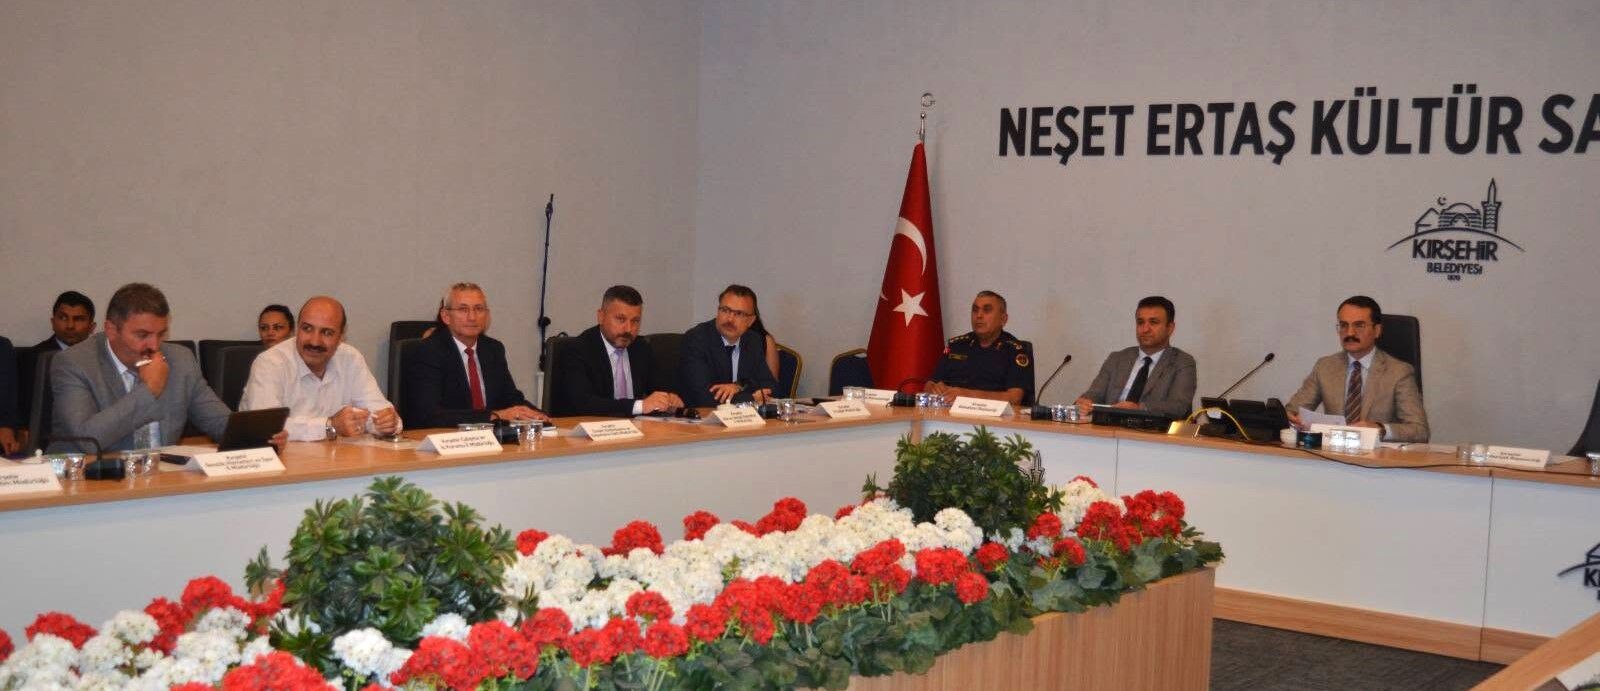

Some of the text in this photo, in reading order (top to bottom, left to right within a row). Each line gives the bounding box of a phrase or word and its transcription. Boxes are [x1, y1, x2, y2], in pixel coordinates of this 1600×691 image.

[998, 83, 1600, 166] NEŞET ERTAŞ KÜLTÜR SA
